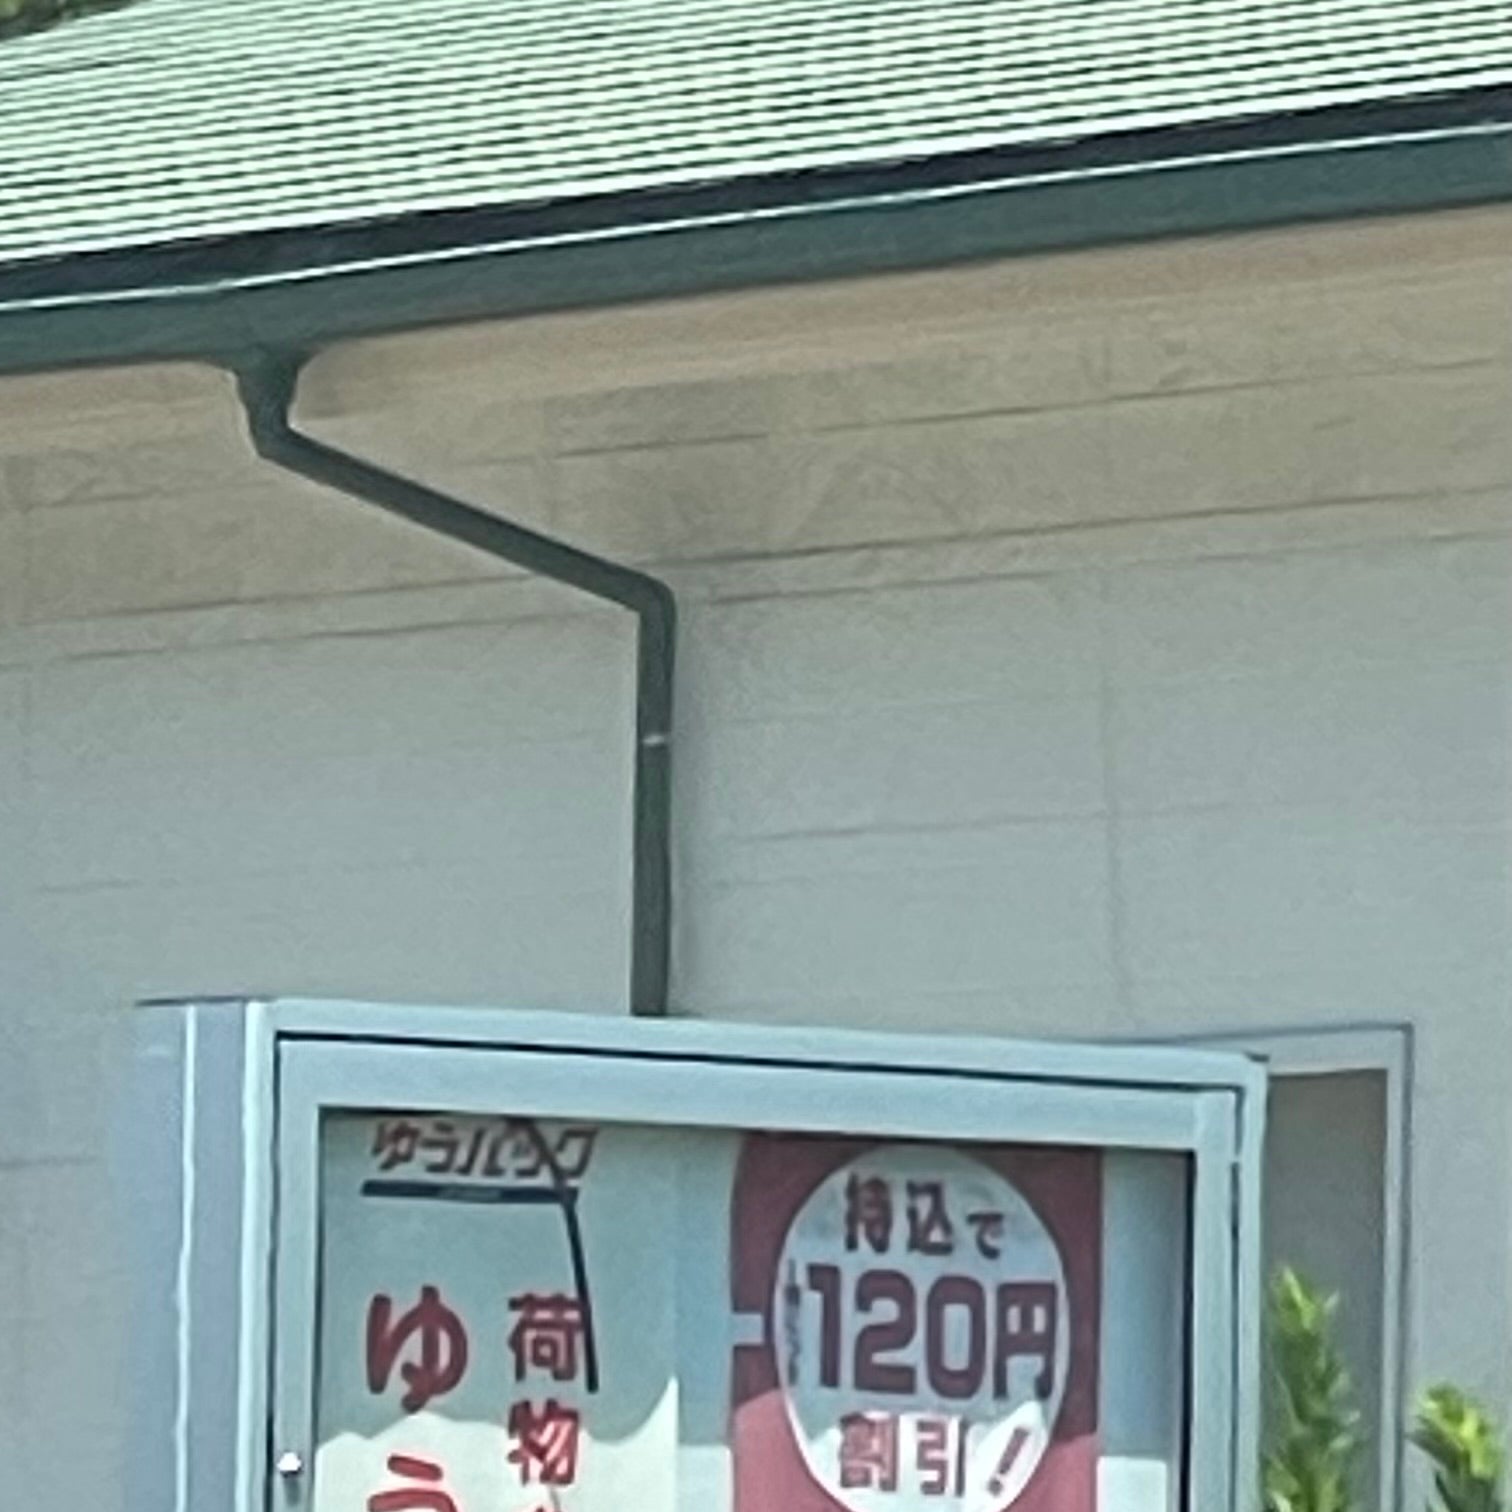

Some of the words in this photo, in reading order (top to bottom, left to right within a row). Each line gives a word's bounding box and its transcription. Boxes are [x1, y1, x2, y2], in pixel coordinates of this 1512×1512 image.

[843, 1172, 1005, 1260] 持込で
[806, 1262, 1058, 1401] 120円
